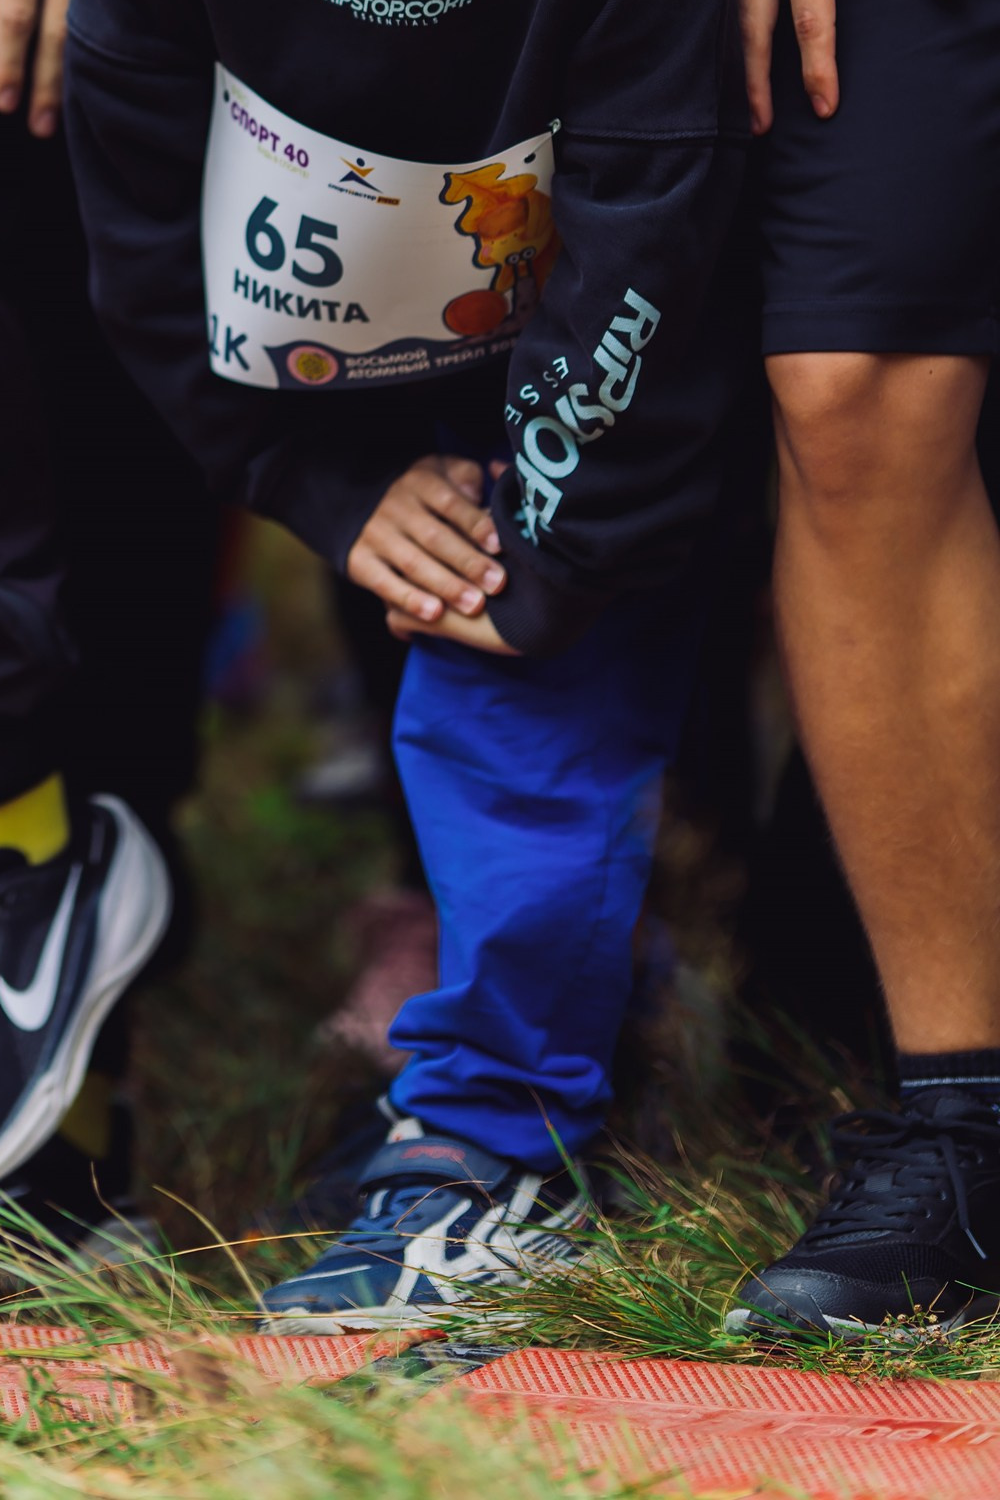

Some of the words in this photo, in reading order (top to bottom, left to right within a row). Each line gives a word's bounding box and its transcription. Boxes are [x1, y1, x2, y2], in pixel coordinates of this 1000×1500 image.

[353, 10, 438, 27] ESSENTIALS
[231, 101, 280, 152] СПОРТ
[283, 143, 309, 168] 40
[245, 195, 344, 288] 65
[233, 267, 370, 324] НИКИТА
[345, 347, 428, 368] ВОСЬМОЙ
[347, 359, 430, 379] АТОМНЫЙ
